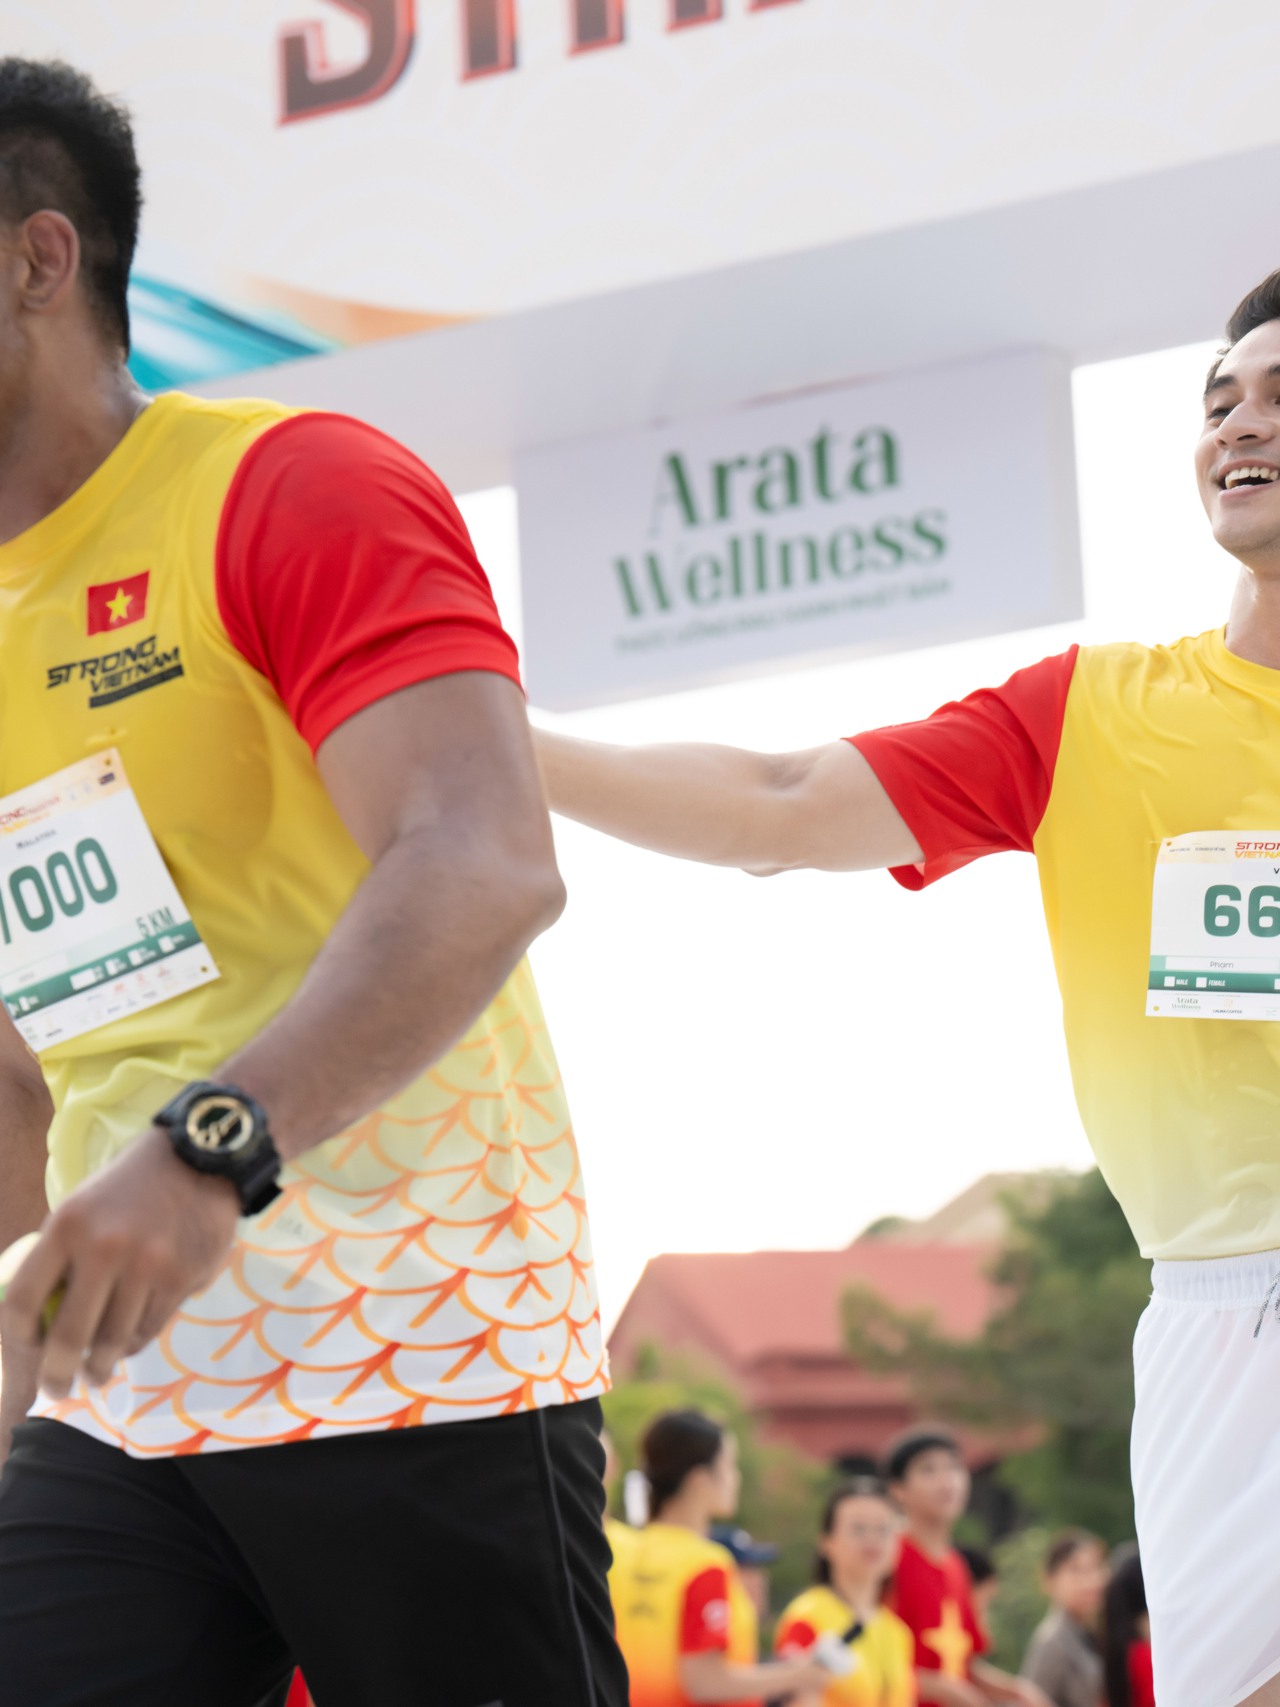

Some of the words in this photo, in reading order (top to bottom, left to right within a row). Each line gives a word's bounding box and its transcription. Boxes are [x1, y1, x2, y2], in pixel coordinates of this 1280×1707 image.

[648, 422, 900, 540] Arata
[614, 506, 948, 618] Wellness
[46, 635, 156, 689] STRONG
[90, 646, 179, 694] VIETNAM
[1208, 979, 1226, 987] FEMALE
